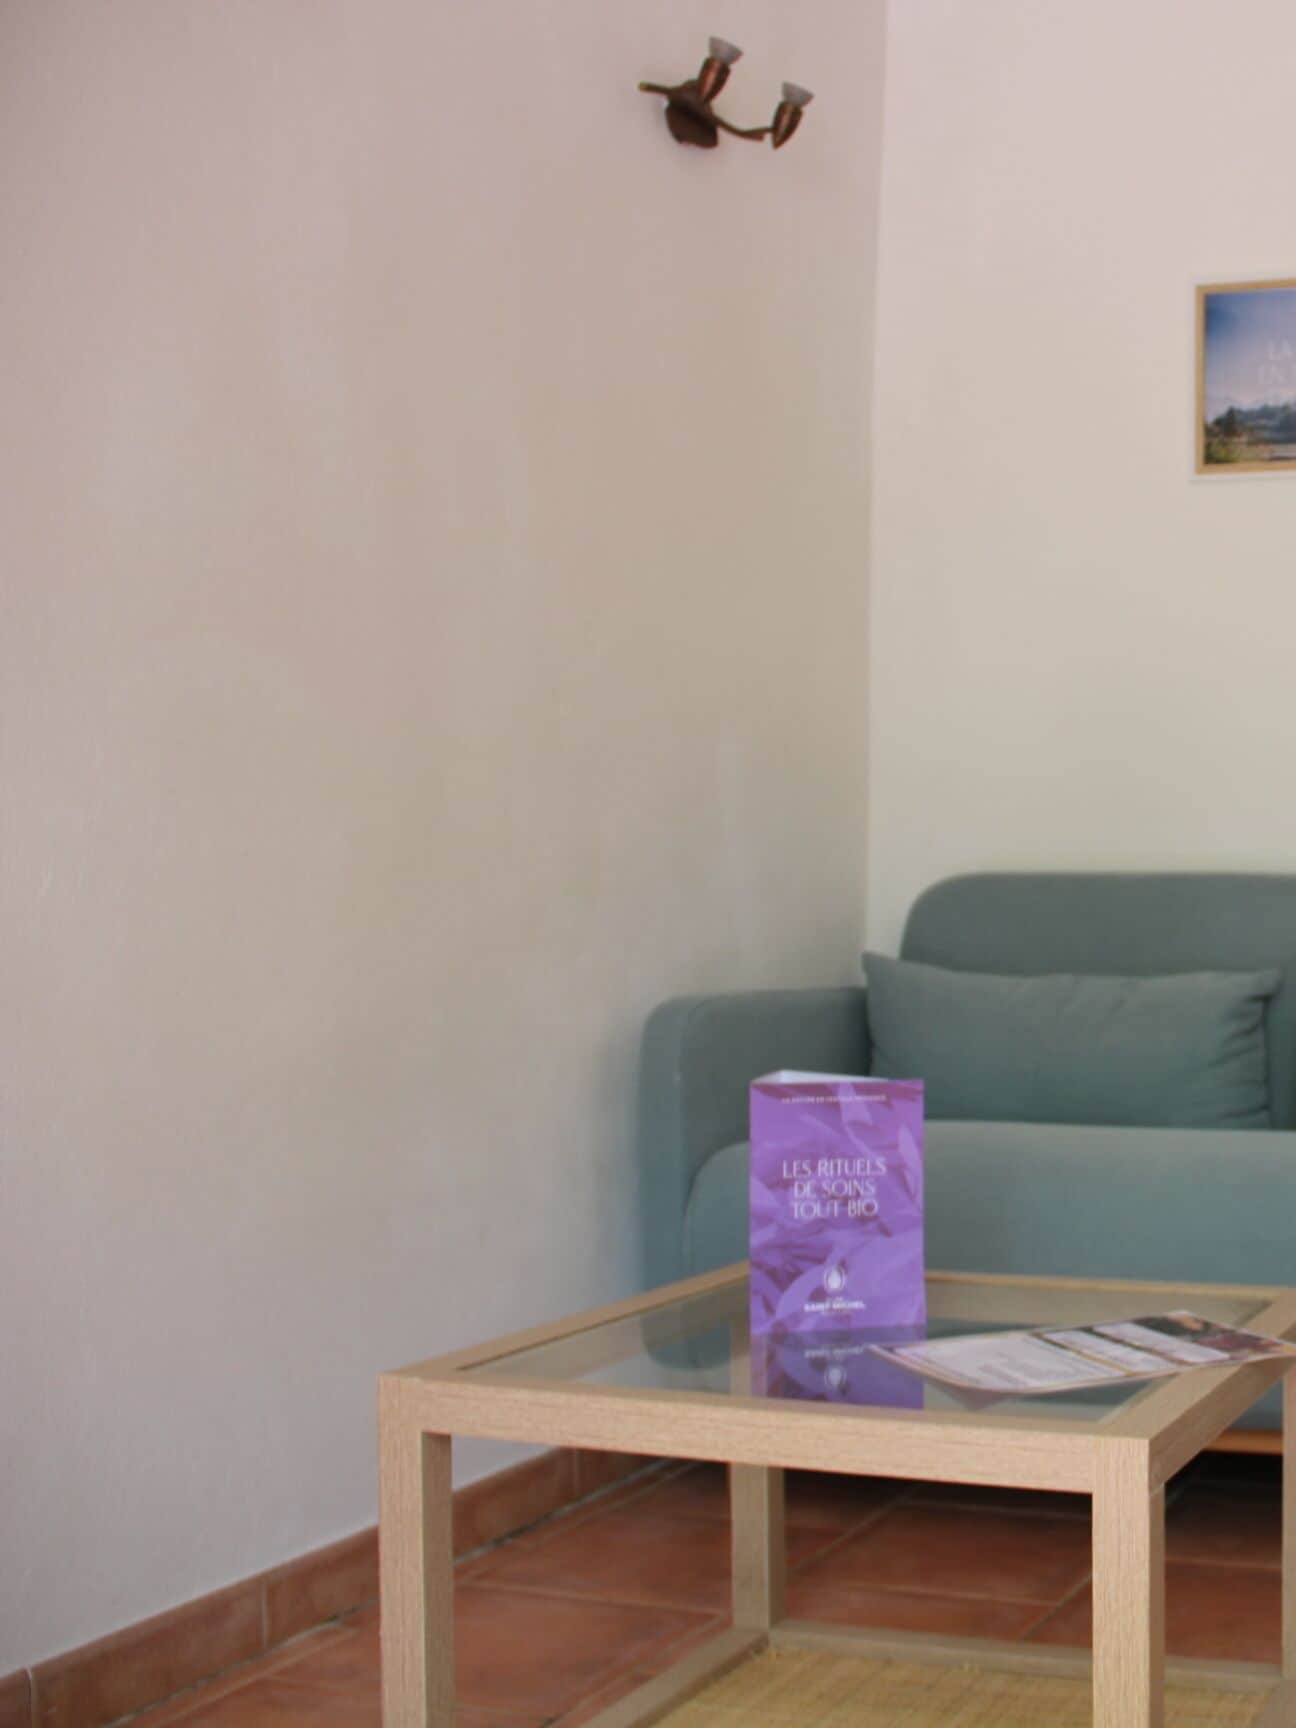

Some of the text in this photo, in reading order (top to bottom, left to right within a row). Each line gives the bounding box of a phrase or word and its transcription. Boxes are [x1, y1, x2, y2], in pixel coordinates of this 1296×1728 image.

[782, 1157, 888, 1179] LES RITUELS
[794, 1178, 876, 1198] DE SOINS
[791, 1198, 879, 1220] TOUT BIO
